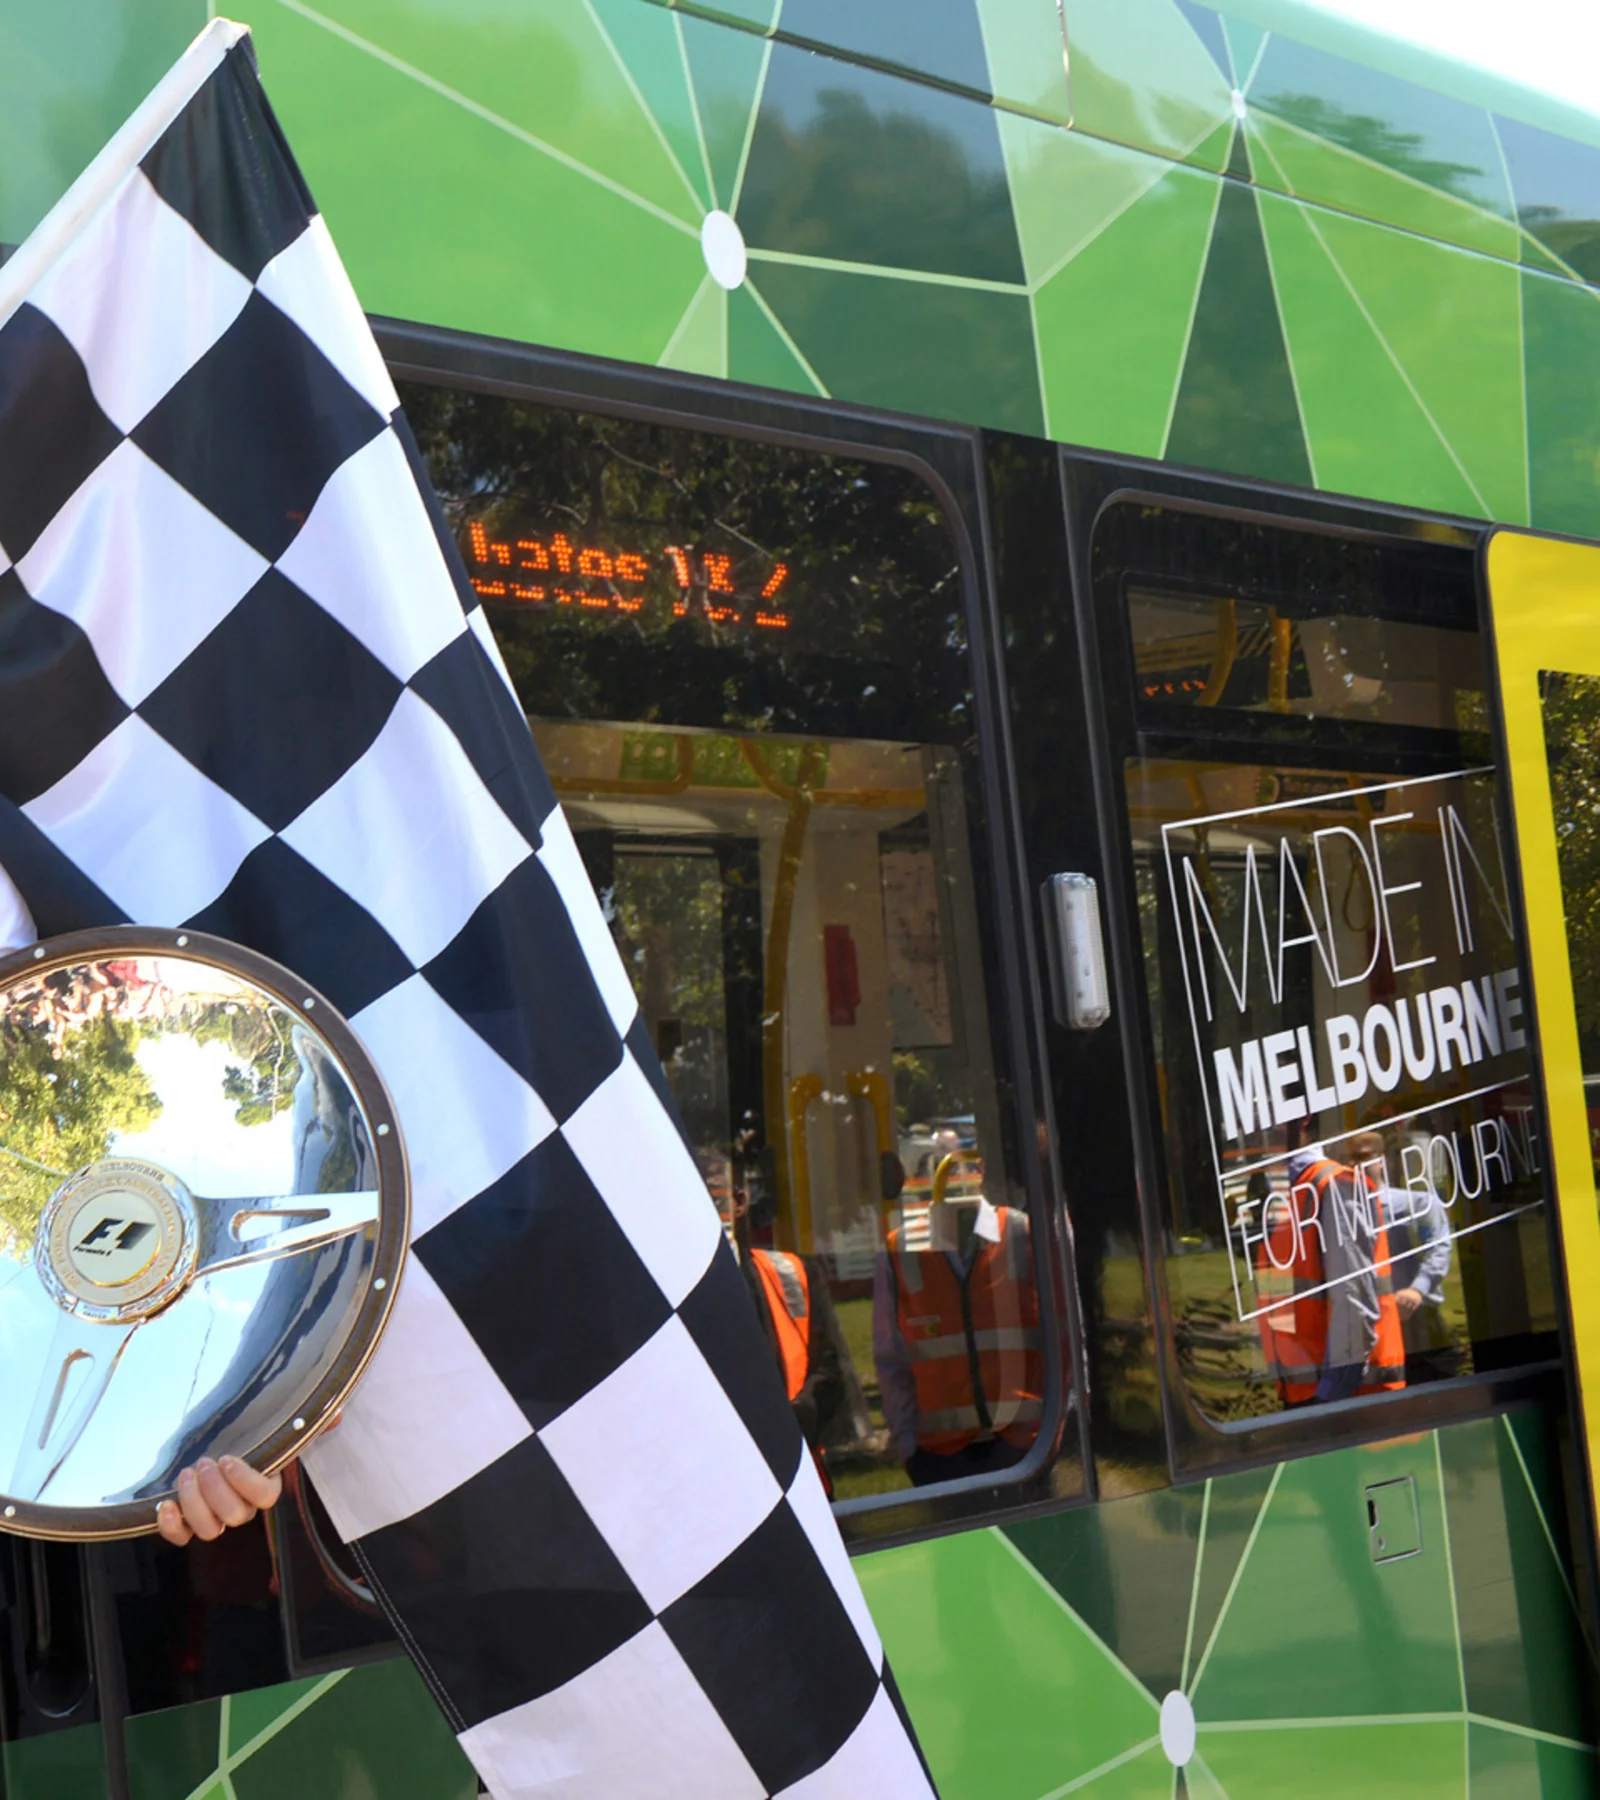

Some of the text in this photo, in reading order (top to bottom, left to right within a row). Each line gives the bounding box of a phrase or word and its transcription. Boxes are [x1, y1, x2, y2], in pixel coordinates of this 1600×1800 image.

[1182, 797, 1516, 1023] MADE IN
[1213, 967, 1527, 1142] MELBOURNE
[1236, 1105, 1542, 1282] FOR MELBOURNE
